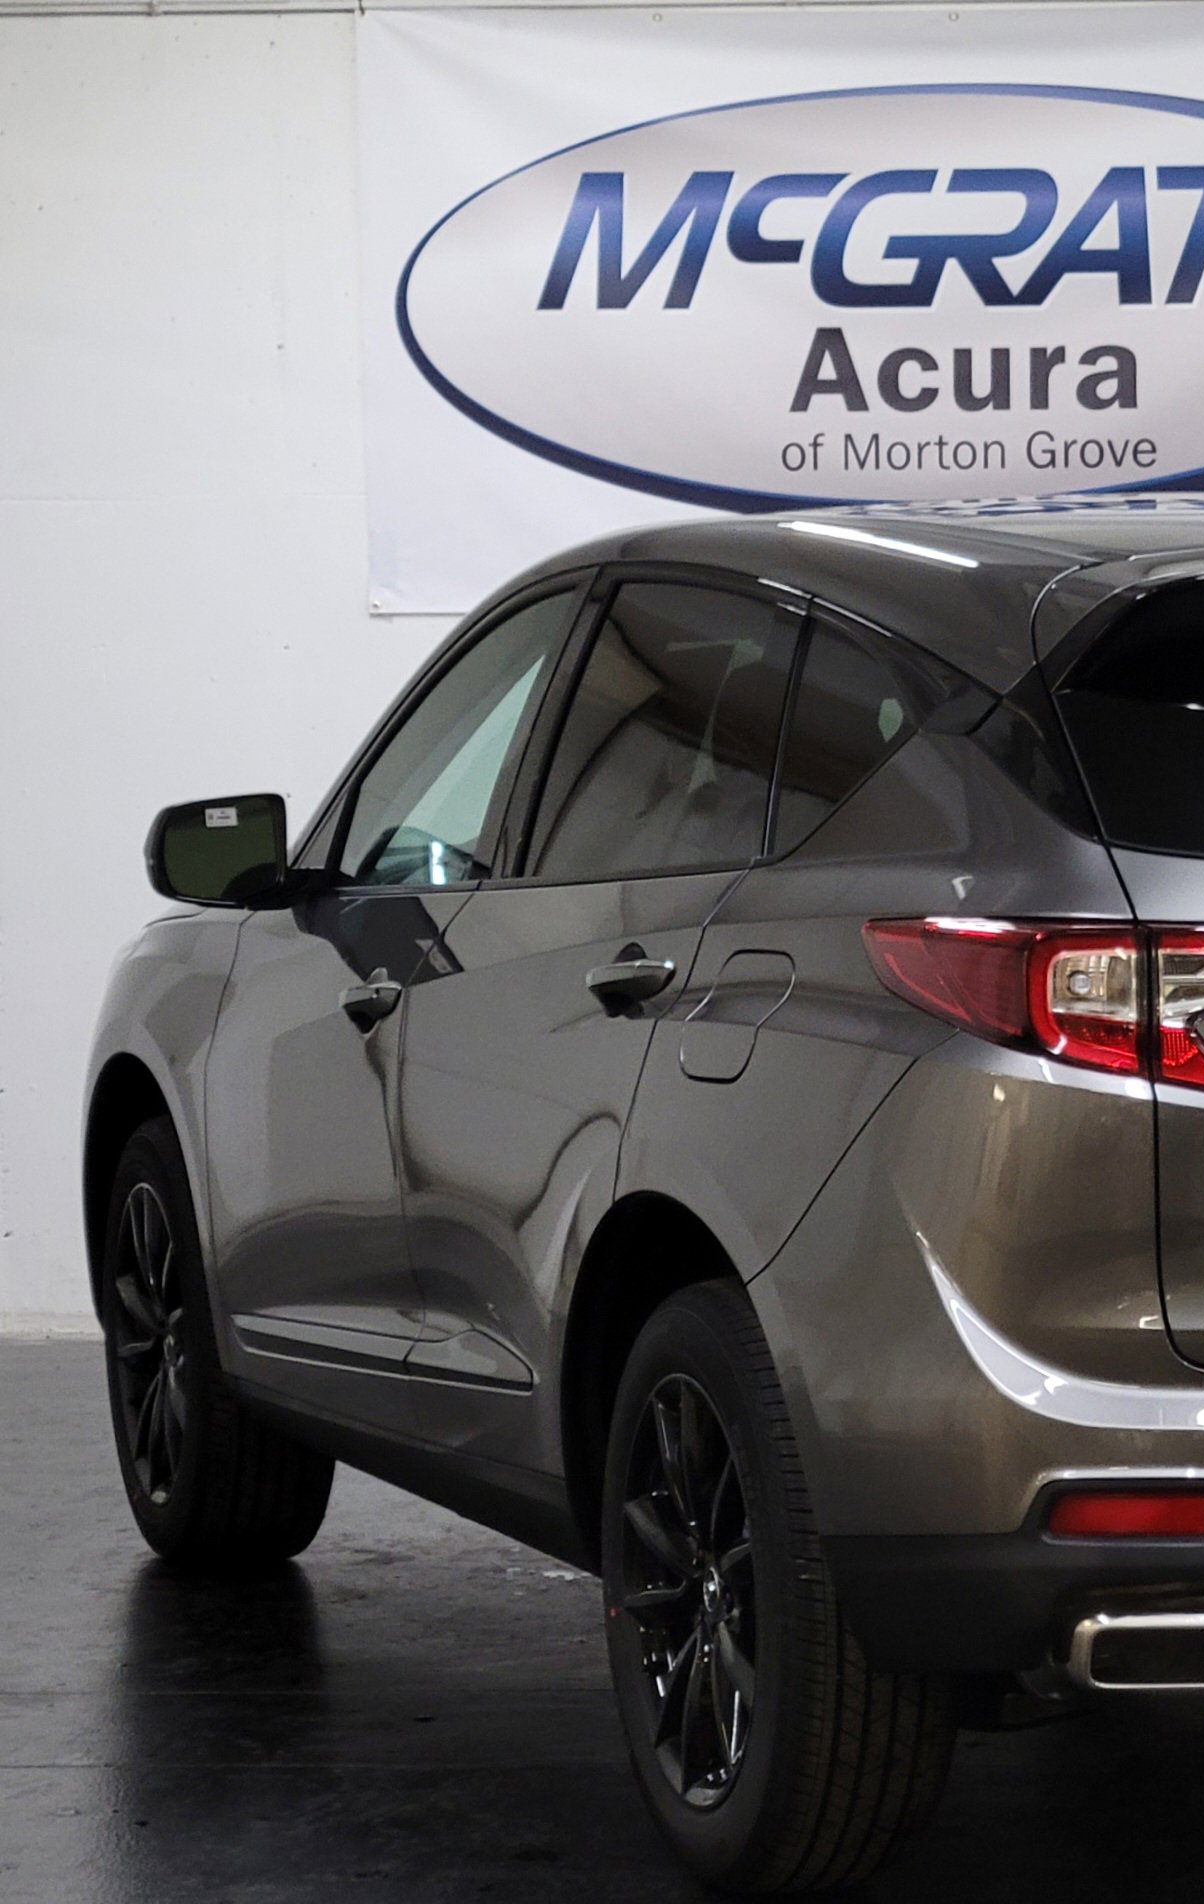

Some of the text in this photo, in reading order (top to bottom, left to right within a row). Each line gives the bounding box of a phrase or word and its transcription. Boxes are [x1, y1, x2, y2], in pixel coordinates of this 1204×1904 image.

[791, 327, 1139, 412] Acura
[781, 432, 1158, 472] of Morton Grove
